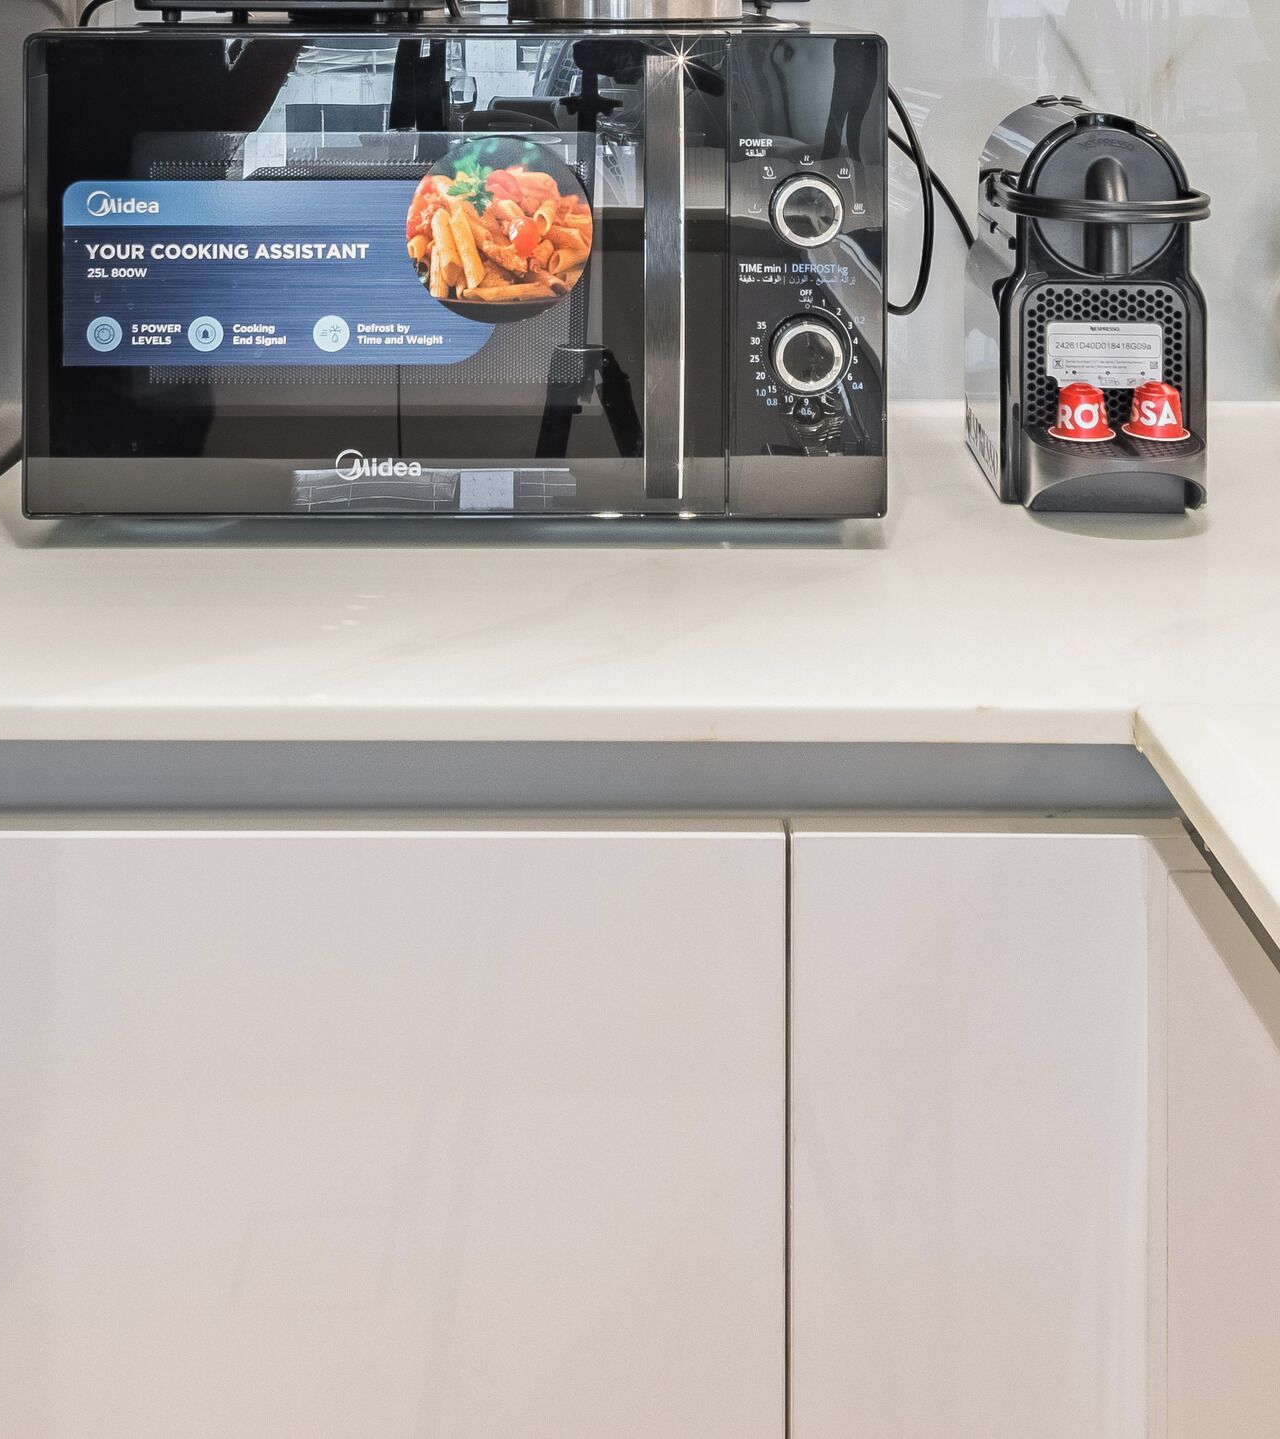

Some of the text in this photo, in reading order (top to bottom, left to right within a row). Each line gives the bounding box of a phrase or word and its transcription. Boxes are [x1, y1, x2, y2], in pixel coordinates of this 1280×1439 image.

[739, 139, 773, 147] POWER
[91, 194, 160, 215] Midea
[85, 243, 370, 260] YOUR COOKING ASSISTANT
[87, 268, 147, 278] 25L 800W
[739, 263, 849, 275] TIME min DEFROST kg
[836, 308, 842, 316] 2
[132, 324, 182, 333] 5 POWER
[233, 323, 275, 335] Cooking
[356, 324, 410, 335] Defrost by
[756, 322, 767, 330] 35
[847, 322, 853, 330] 3
[132, 336, 172, 345] LEVELS
[233, 335, 287, 347] End Signal
[357, 335, 443, 347] Time and Weight
[750, 337, 761, 345] 30
[853, 337, 859, 345] 4
[749, 355, 760, 363] 25
[853, 356, 859, 364] 5
[755, 372, 766, 380] 20
[847, 373, 853, 381] 6
[767, 385, 777, 393] 15
[852, 382, 863, 390] 0.4
[755, 389, 766, 397] 1.0
[766, 398, 778, 406] 0.8
[784, 395, 794, 403] 10
[804, 398, 810, 406] 9
[340, 453, 422, 478] Midea
